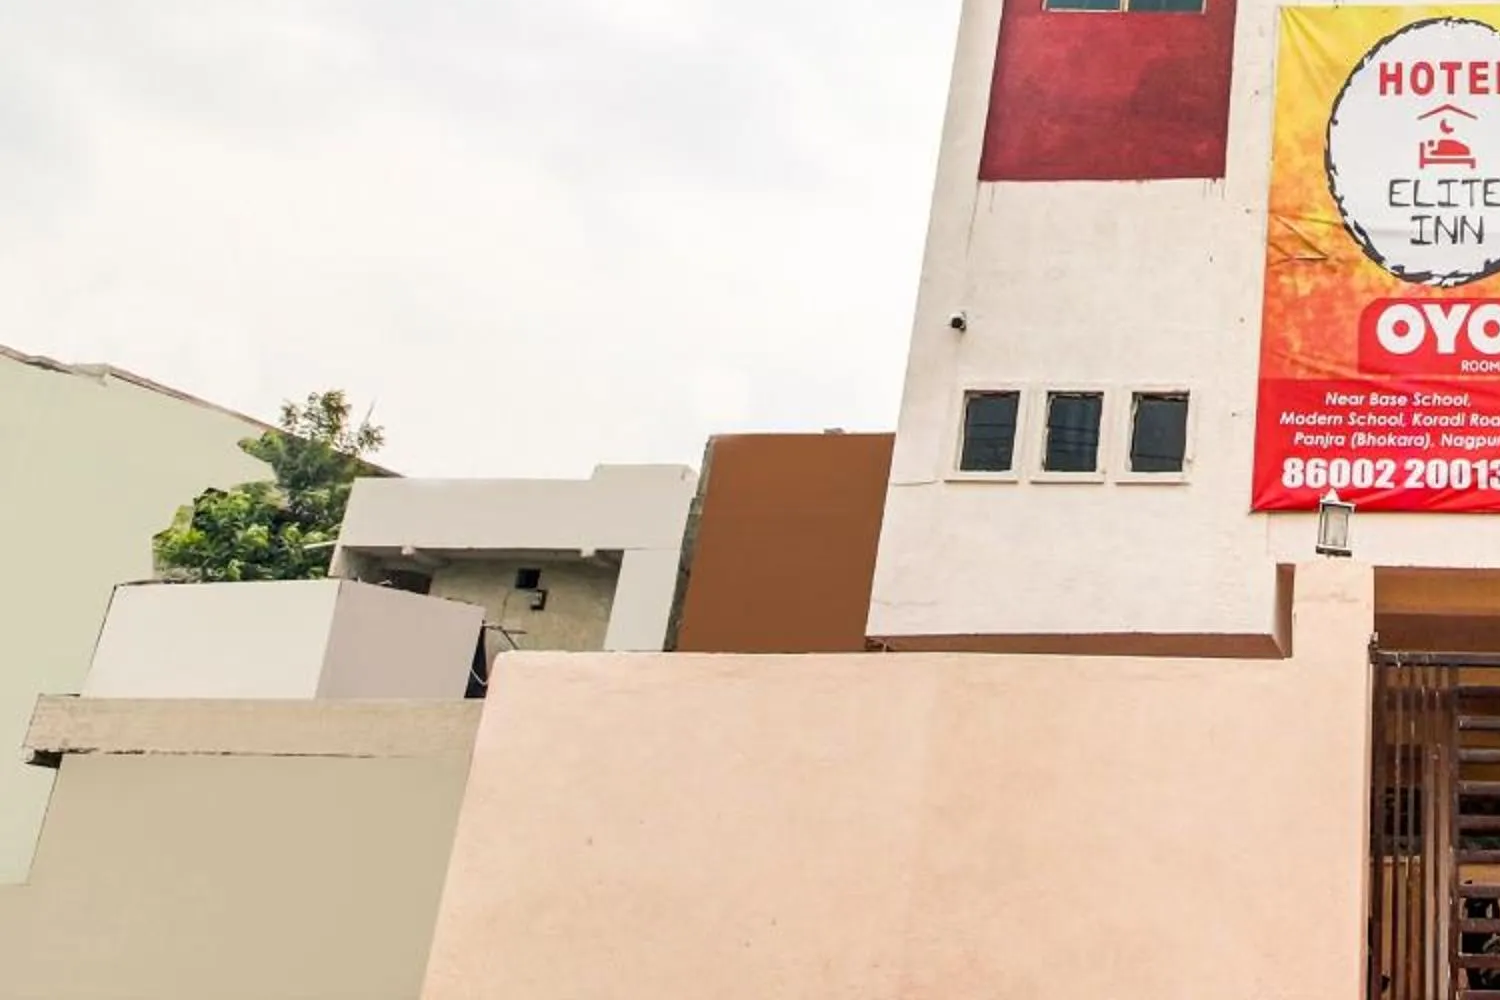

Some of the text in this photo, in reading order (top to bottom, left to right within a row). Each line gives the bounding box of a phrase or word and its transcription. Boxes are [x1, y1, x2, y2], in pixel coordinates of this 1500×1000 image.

[1409, 215, 1485, 246] INN
[1325, 392, 1365, 406] Near
[1369, 392, 1408, 407] Base
[1280, 412, 1343, 426] Modern
[1411, 412, 1466, 427] Koradi
[1293, 432, 1345, 449] Panjra
[1281, 456, 1396, 489] 86002
